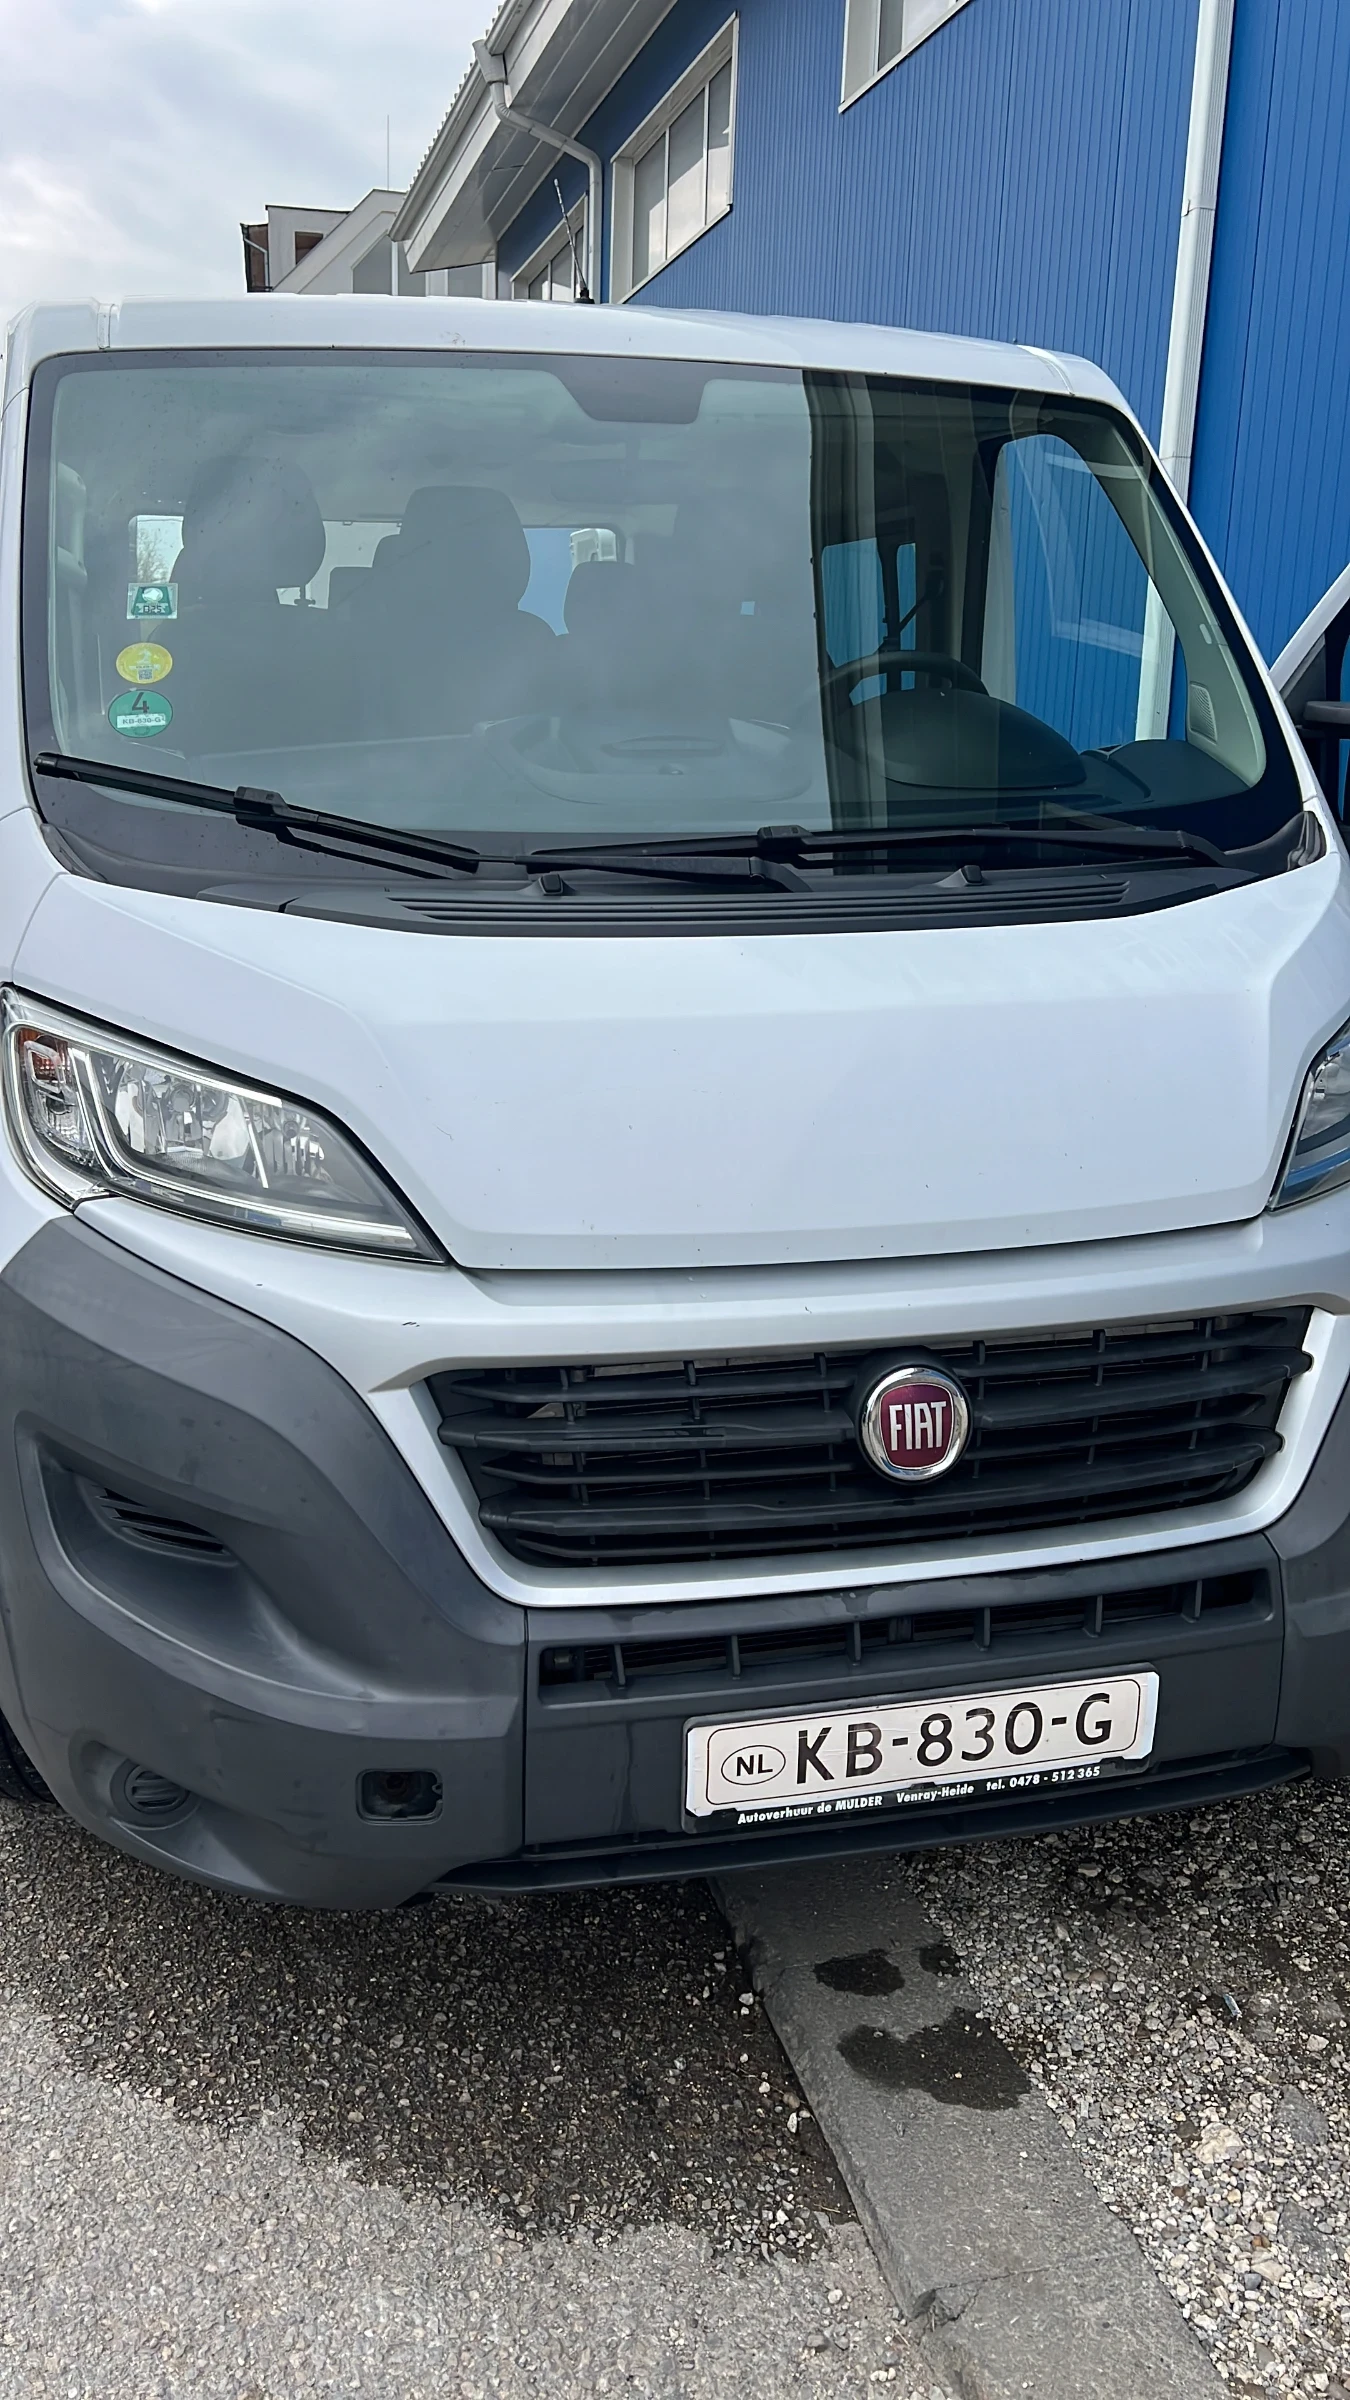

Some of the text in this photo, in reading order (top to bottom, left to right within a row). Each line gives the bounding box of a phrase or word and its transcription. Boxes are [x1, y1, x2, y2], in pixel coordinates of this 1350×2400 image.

[132, 692, 149, 714] 4
[889, 1402, 947, 1451] FIAT
[736, 1693, 1111, 1784] NL KB-830-G
[737, 1806, 813, 1824] Autoverhuur
[817, 1802, 831, 1813] de
[835, 1796, 882, 1811] MULDER
[896, 1785, 974, 1803] Venray-Heide
[986, 1779, 1005, 1791] tel.
[1009, 1774, 1040, 1788] 0478
[1051, 1769, 1075, 1782] 512
[1077, 1766, 1101, 1778] 365
